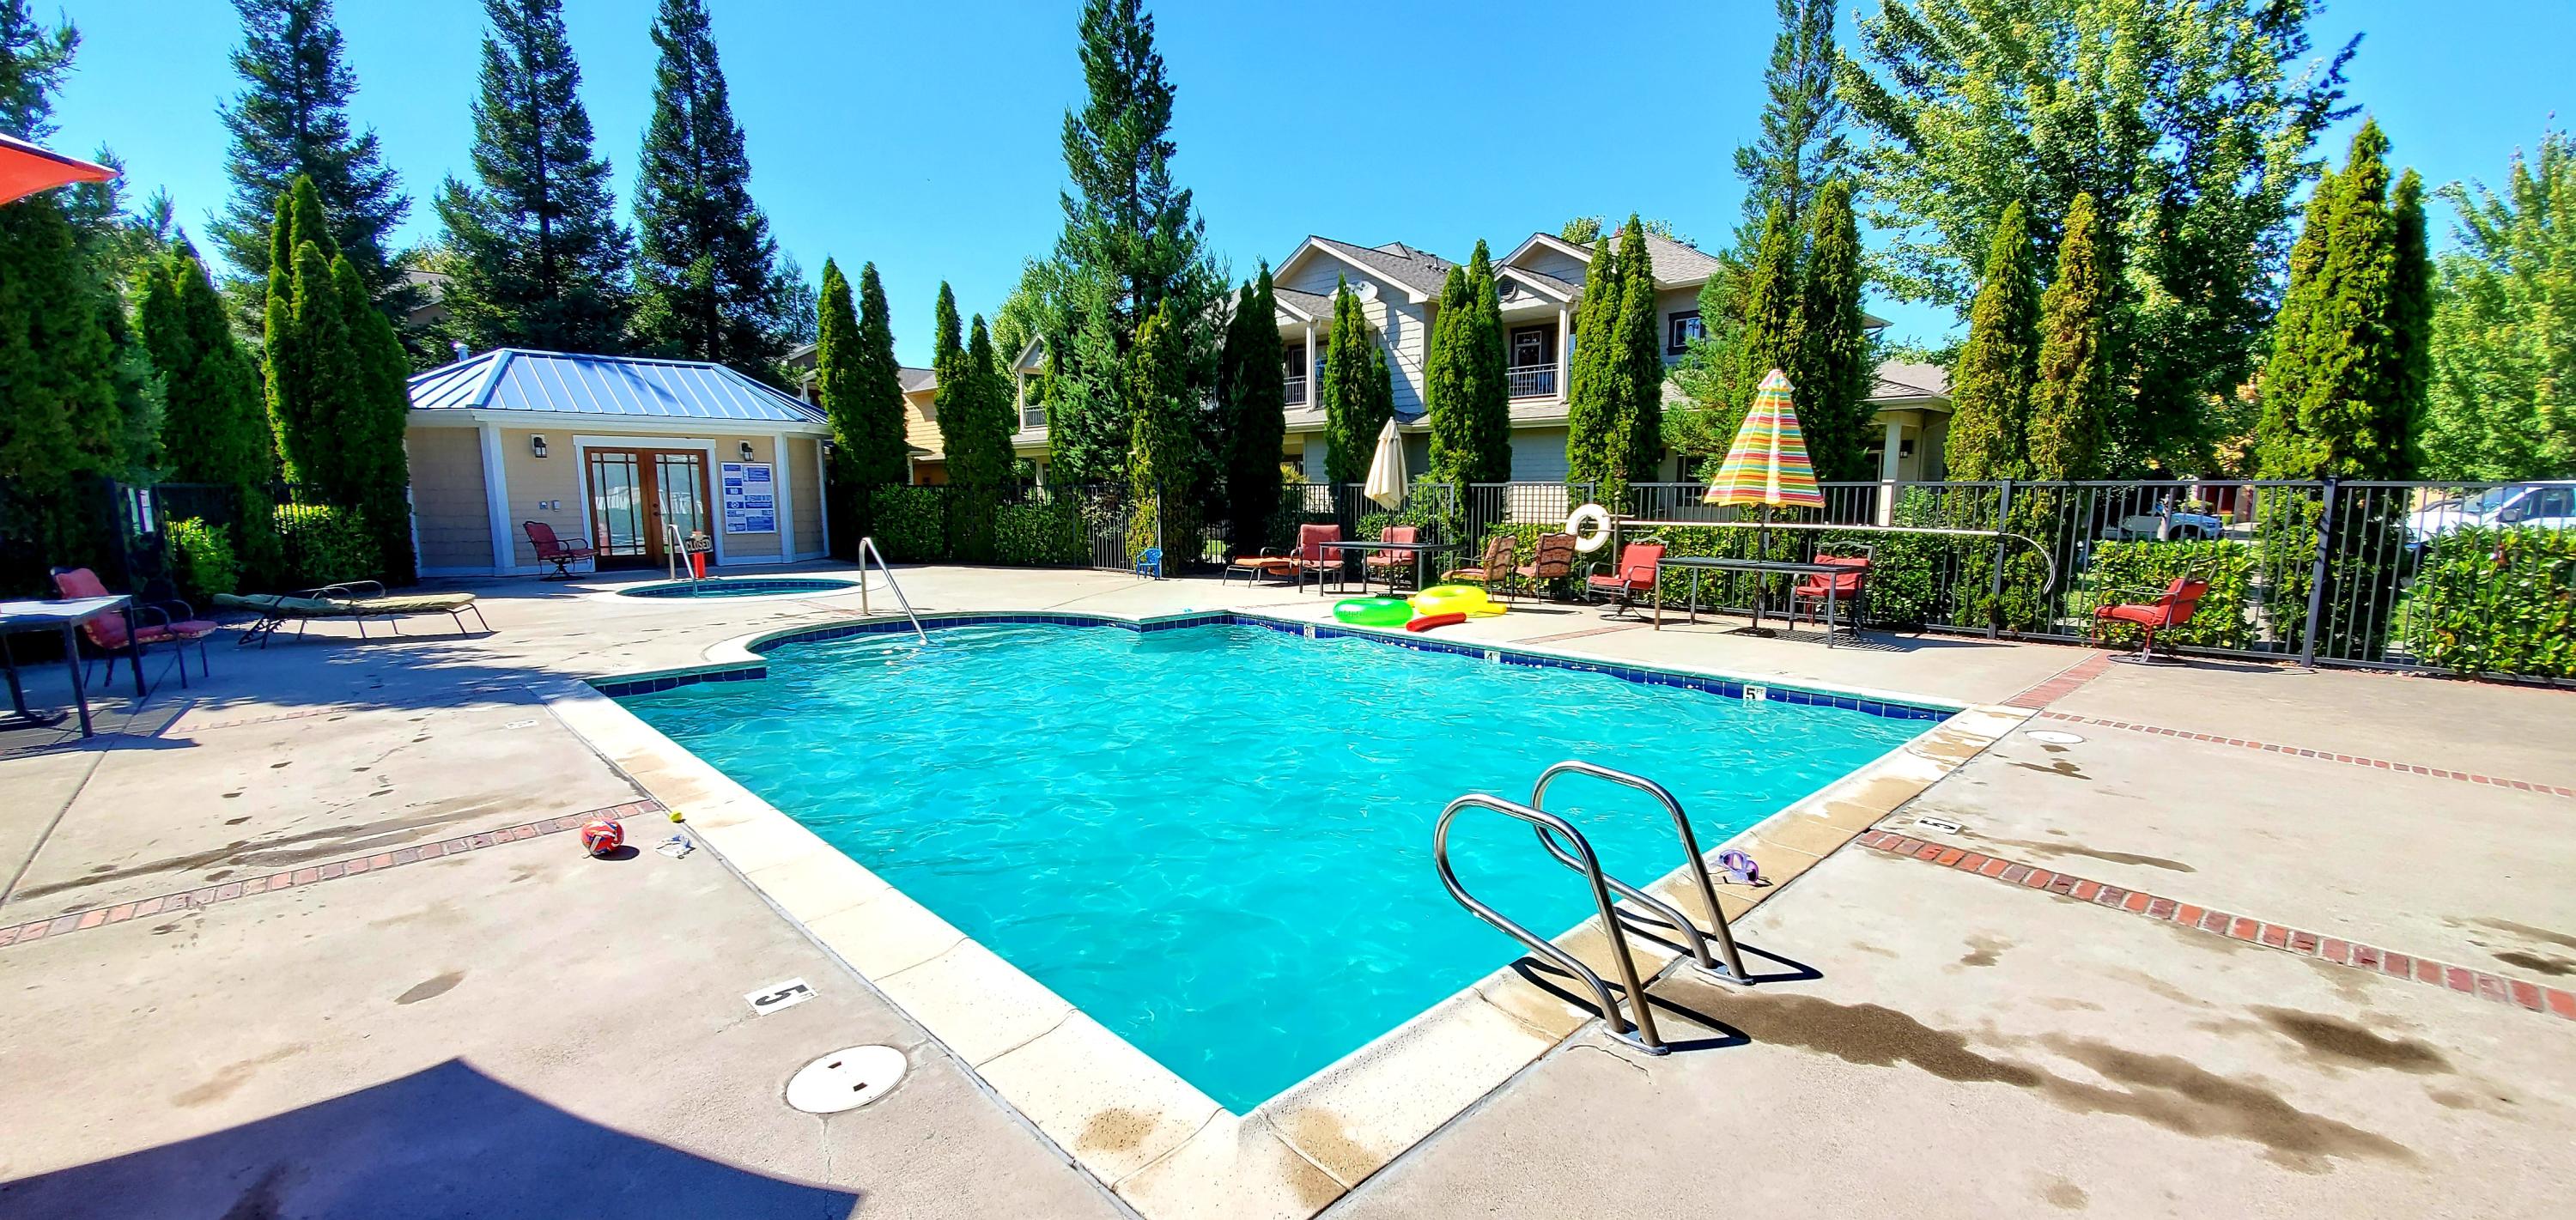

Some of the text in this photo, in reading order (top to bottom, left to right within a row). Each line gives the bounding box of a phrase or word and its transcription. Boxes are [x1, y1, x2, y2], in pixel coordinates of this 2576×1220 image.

[685, 539, 710, 550] CLOSED
[1746, 688, 1755, 700] 5
[1919, 820, 1956, 829] 5
[755, 984, 809, 1005] 5
